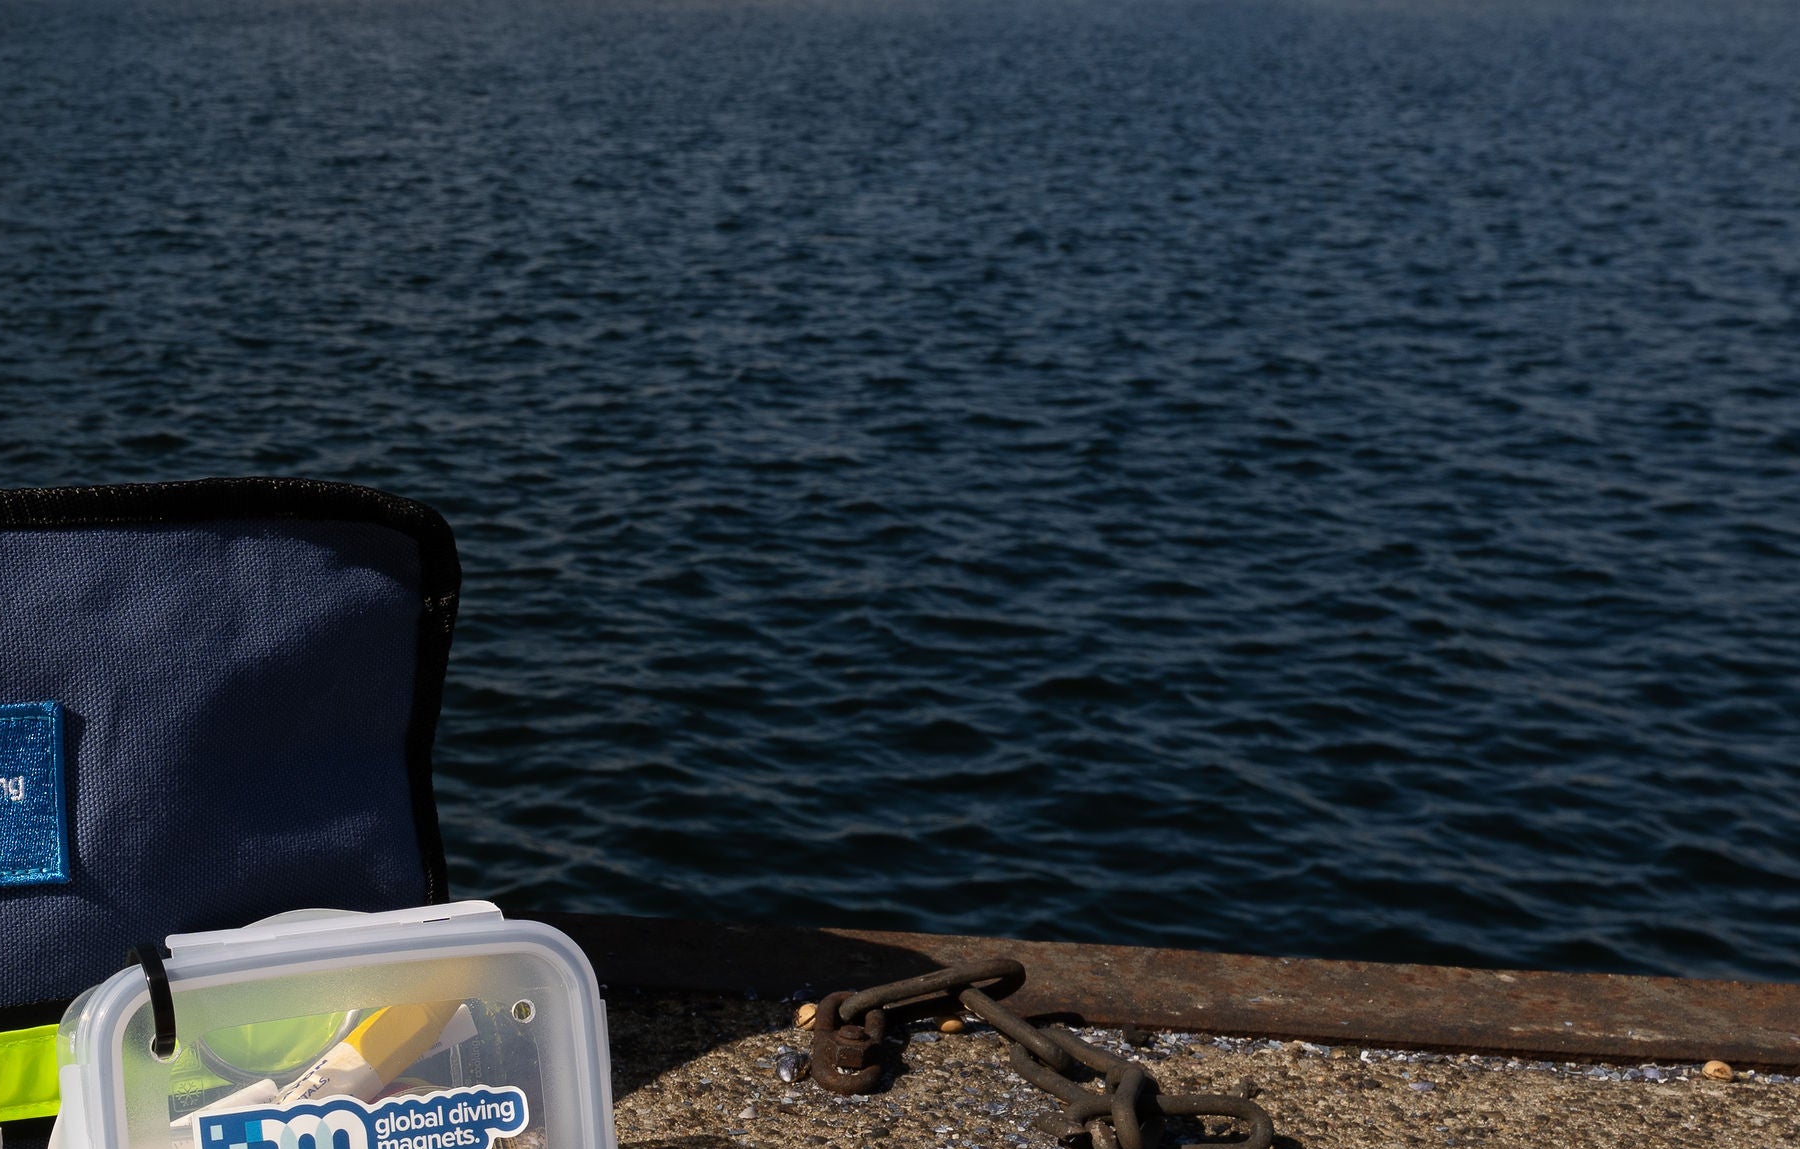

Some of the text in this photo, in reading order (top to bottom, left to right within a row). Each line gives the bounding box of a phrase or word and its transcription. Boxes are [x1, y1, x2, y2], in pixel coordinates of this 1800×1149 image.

[296, 1076, 330, 1100] TALS,
[375, 1099, 516, 1140] global diving
